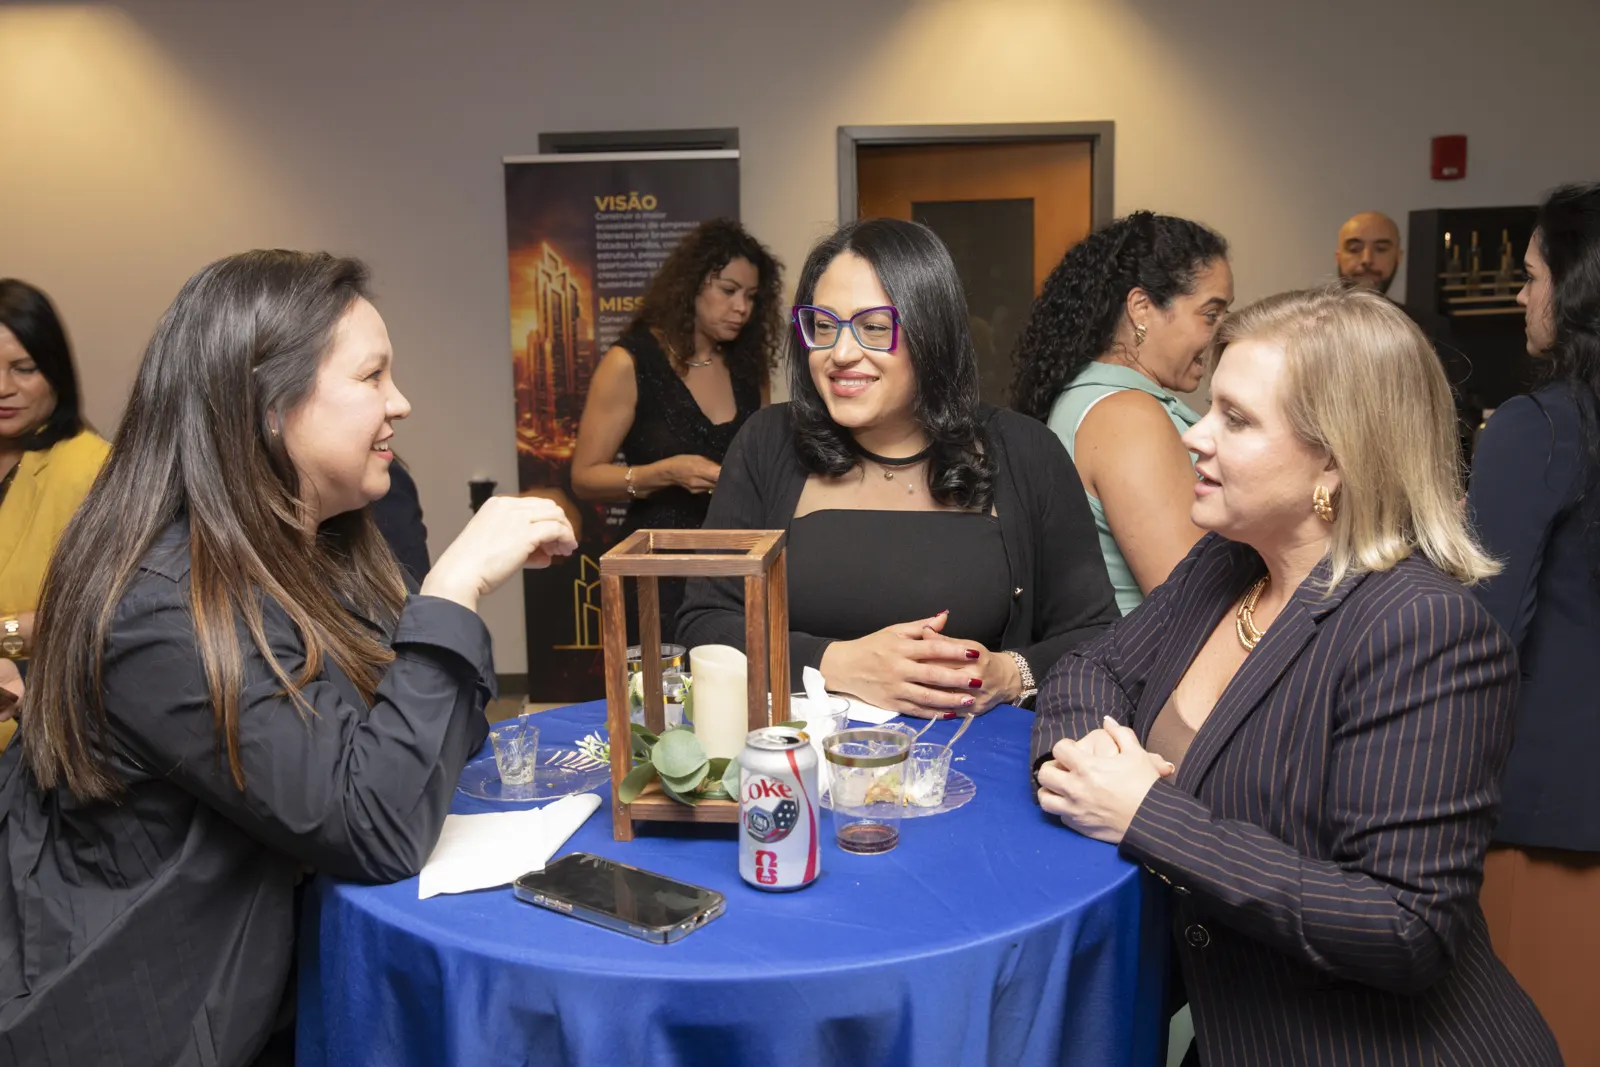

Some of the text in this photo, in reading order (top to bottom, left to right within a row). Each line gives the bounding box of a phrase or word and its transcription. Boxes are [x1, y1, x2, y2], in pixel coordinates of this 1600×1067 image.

[594, 191, 658, 211] VISÃO
[595, 212, 633, 220] Construir
[597, 241, 628, 249] Estados
[597, 261, 657, 270] oportunidades
[598, 271, 648, 279] crescimento
[599, 296, 646, 312] MISS
